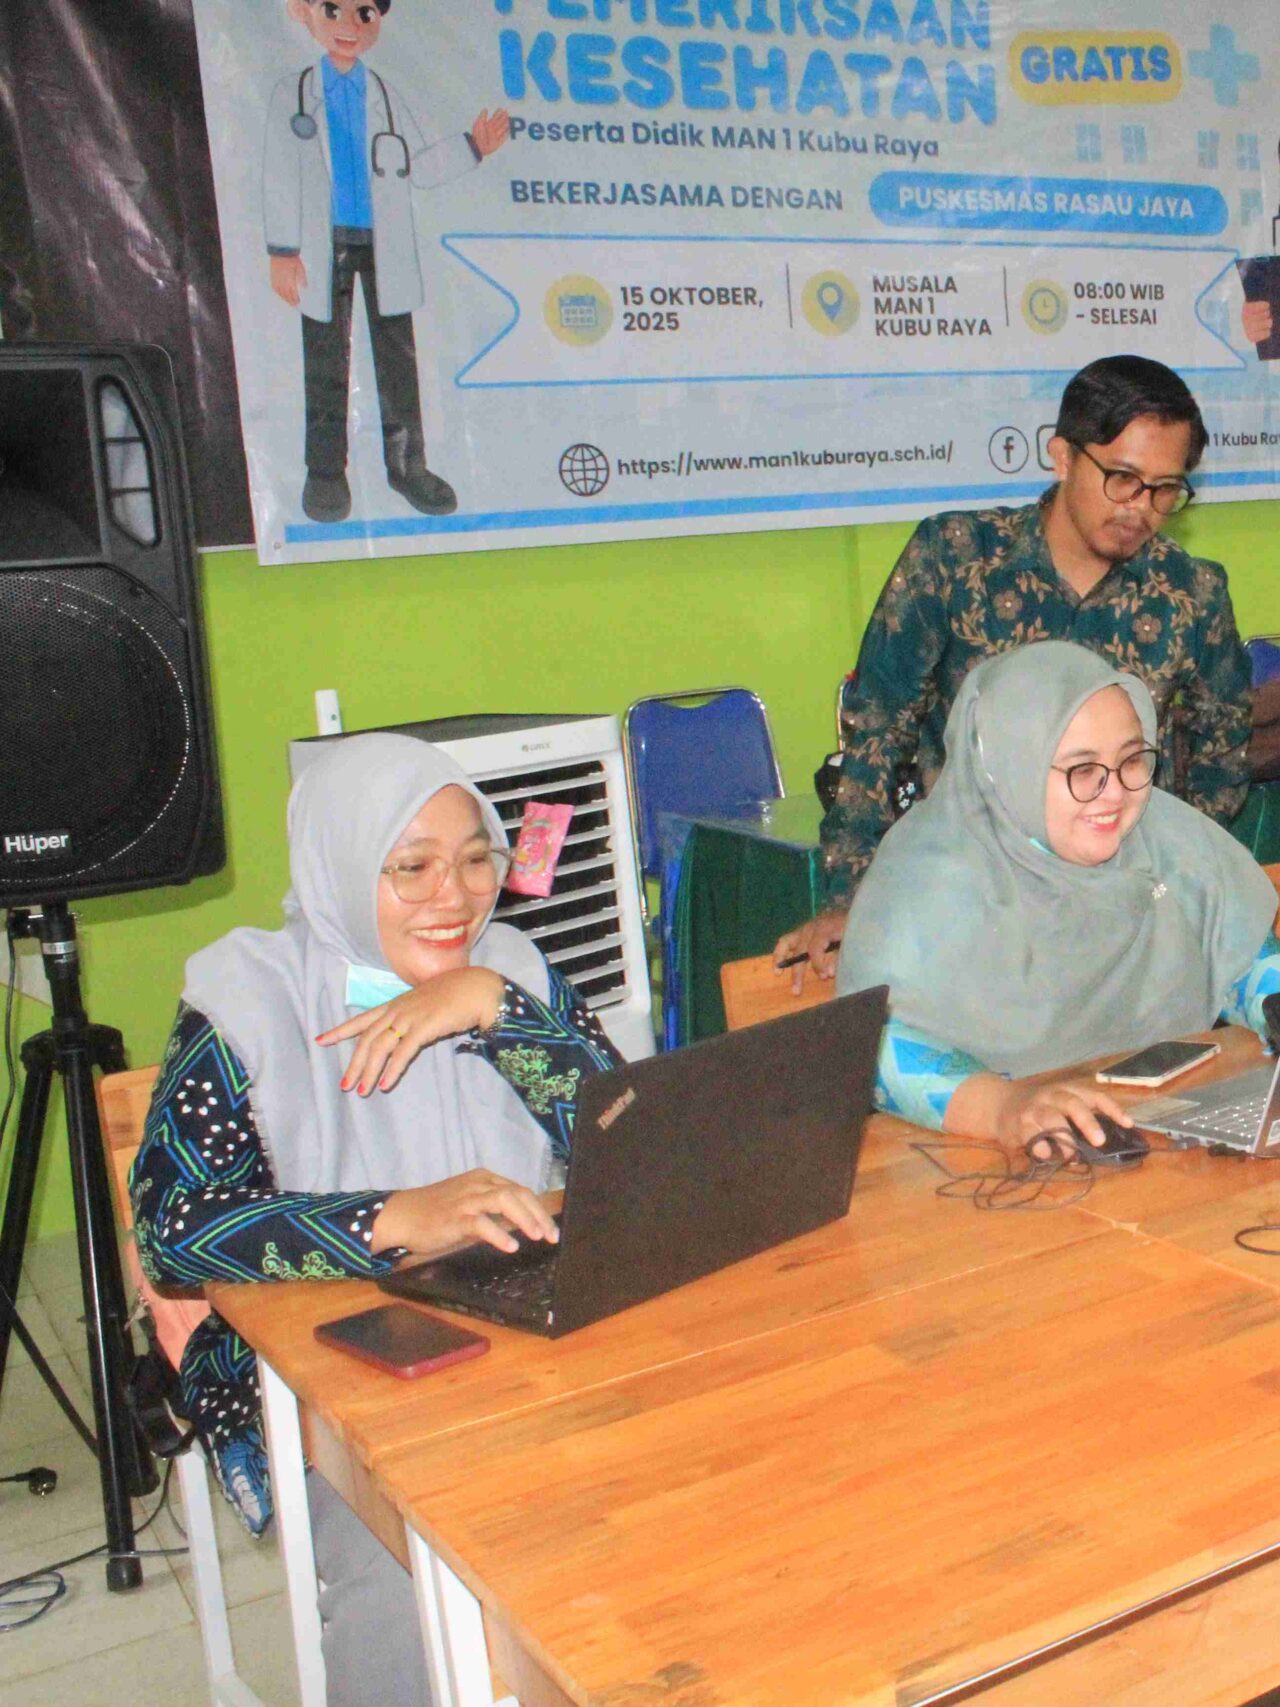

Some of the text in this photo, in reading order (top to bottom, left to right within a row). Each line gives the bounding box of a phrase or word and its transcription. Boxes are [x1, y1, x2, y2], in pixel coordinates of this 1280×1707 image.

[1020, 46, 1172, 84] GRATIS
[499, 29, 997, 126] KESEHATAN
[509, 117, 939, 162] Peserta Didik MAN 1 Kubu Raya
[510, 179, 843, 210] BEKERJASAMA DENGAN
[899, 186, 1195, 219] PUSKESMAS RASAU JAYA
[872, 275, 958, 295] MUSALA
[1074, 281, 1165, 301] 08:00 WIB
[620, 286, 764, 311] 15 OKTOBER,
[874, 297, 936, 316] MAN 1
[622, 312, 681, 332] 2025
[1090, 307, 1158, 326] SELESAI
[875, 317, 993, 337] KUBU RAYA
[1222, 432, 1258, 447] Kubu
[616, 440, 954, 477] https://www.man1kuburaya.sch.id/
[4, 834, 69, 854] Hüper
